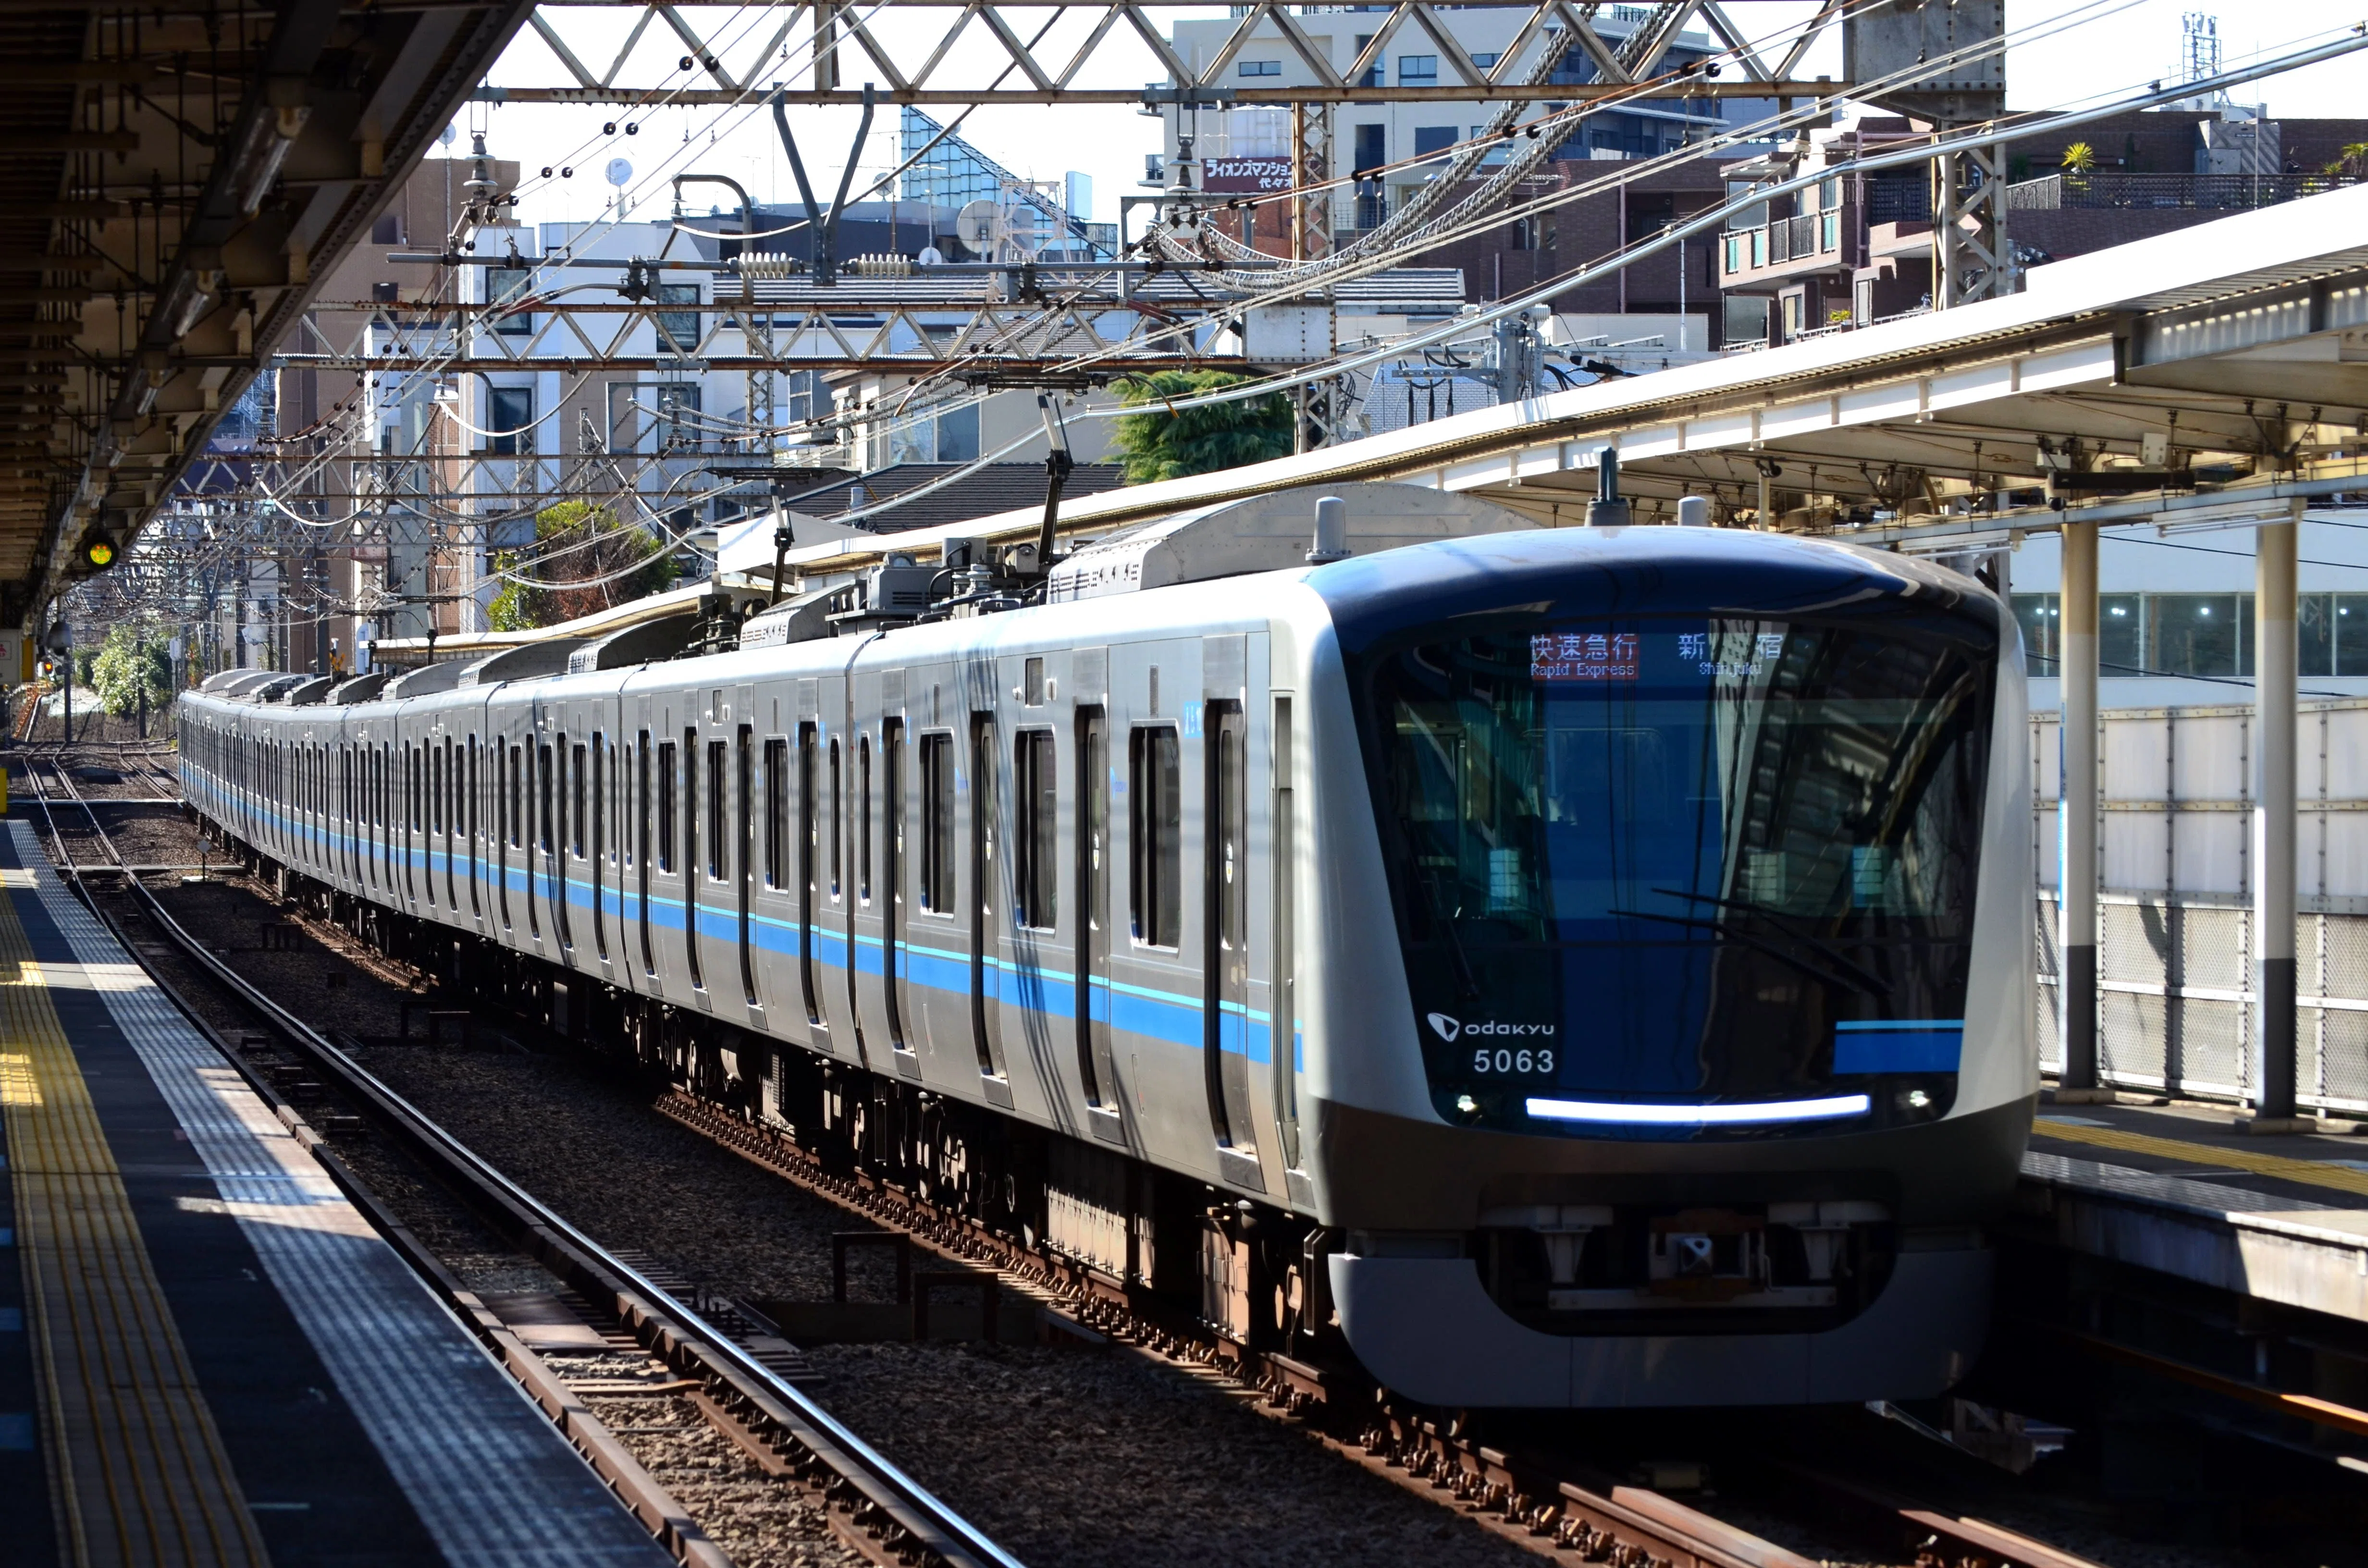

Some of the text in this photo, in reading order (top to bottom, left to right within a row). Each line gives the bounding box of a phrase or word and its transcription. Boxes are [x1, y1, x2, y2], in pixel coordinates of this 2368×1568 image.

[1530, 633, 1637, 661] 快速急行
[1531, 663, 1634, 678] Rapid Express
[1699, 662, 1762, 677] Shinjuku
[1474, 1050, 1553, 1072] 5063
